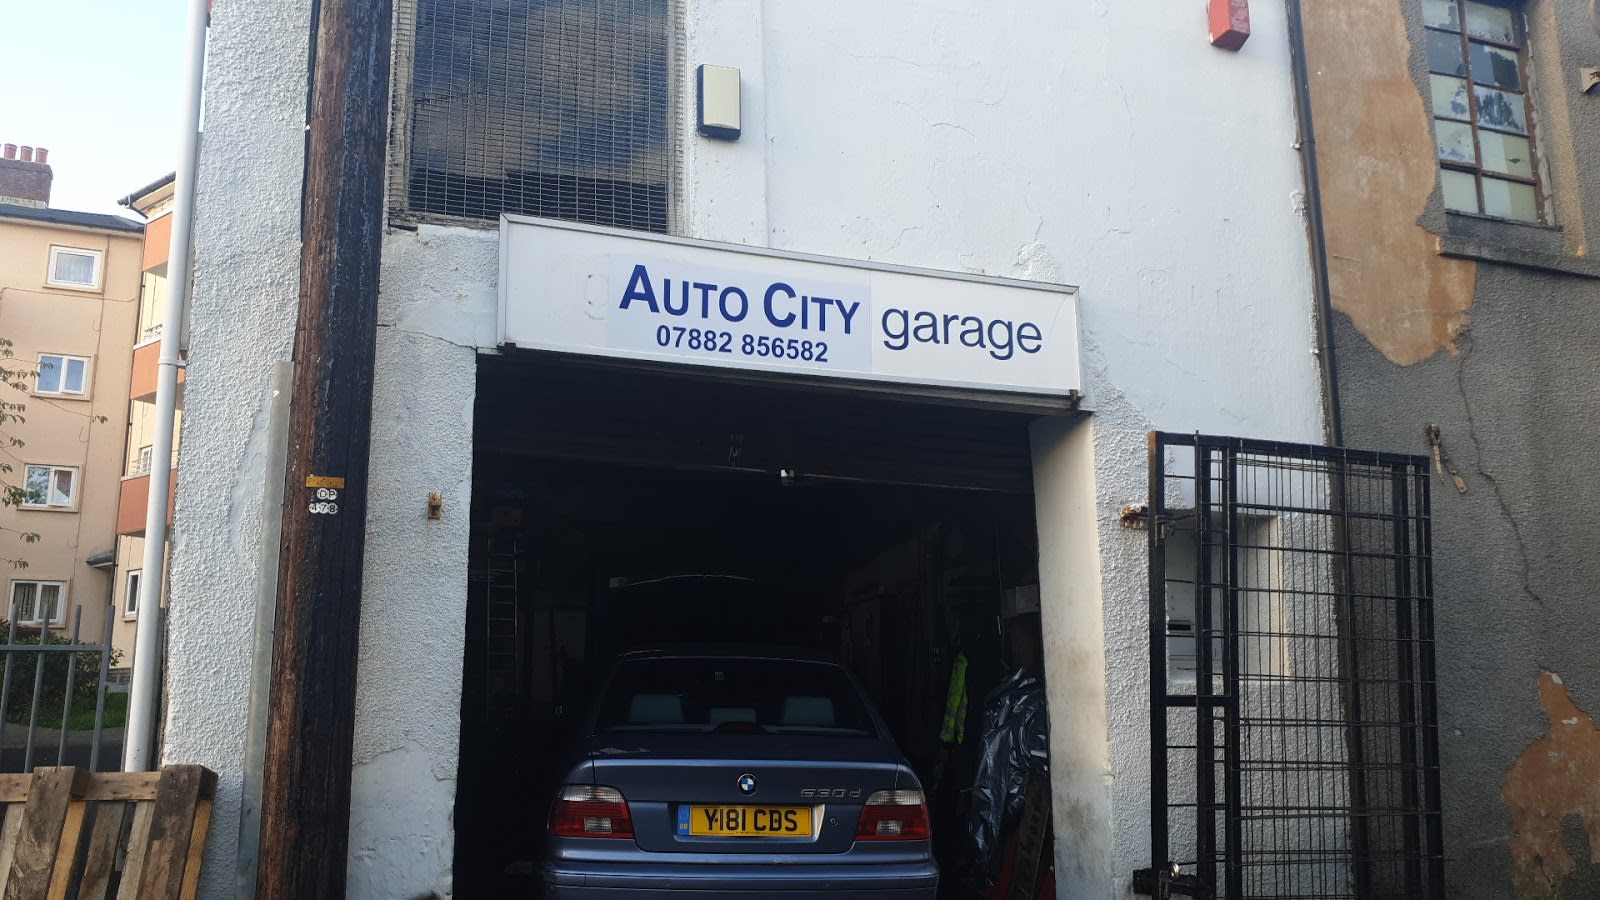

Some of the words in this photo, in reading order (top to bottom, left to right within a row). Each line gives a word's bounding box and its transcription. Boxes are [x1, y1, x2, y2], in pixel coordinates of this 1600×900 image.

[618, 264, 749, 322] AUTO
[763, 282, 861, 335] CITY
[881, 308, 1043, 361] garage
[656, 324, 733, 353] 07882
[741, 334, 828, 363] 856582
[311, 503, 336, 513] 478
[704, 808, 746, 832] Y181
[753, 809, 798, 832] CDS
